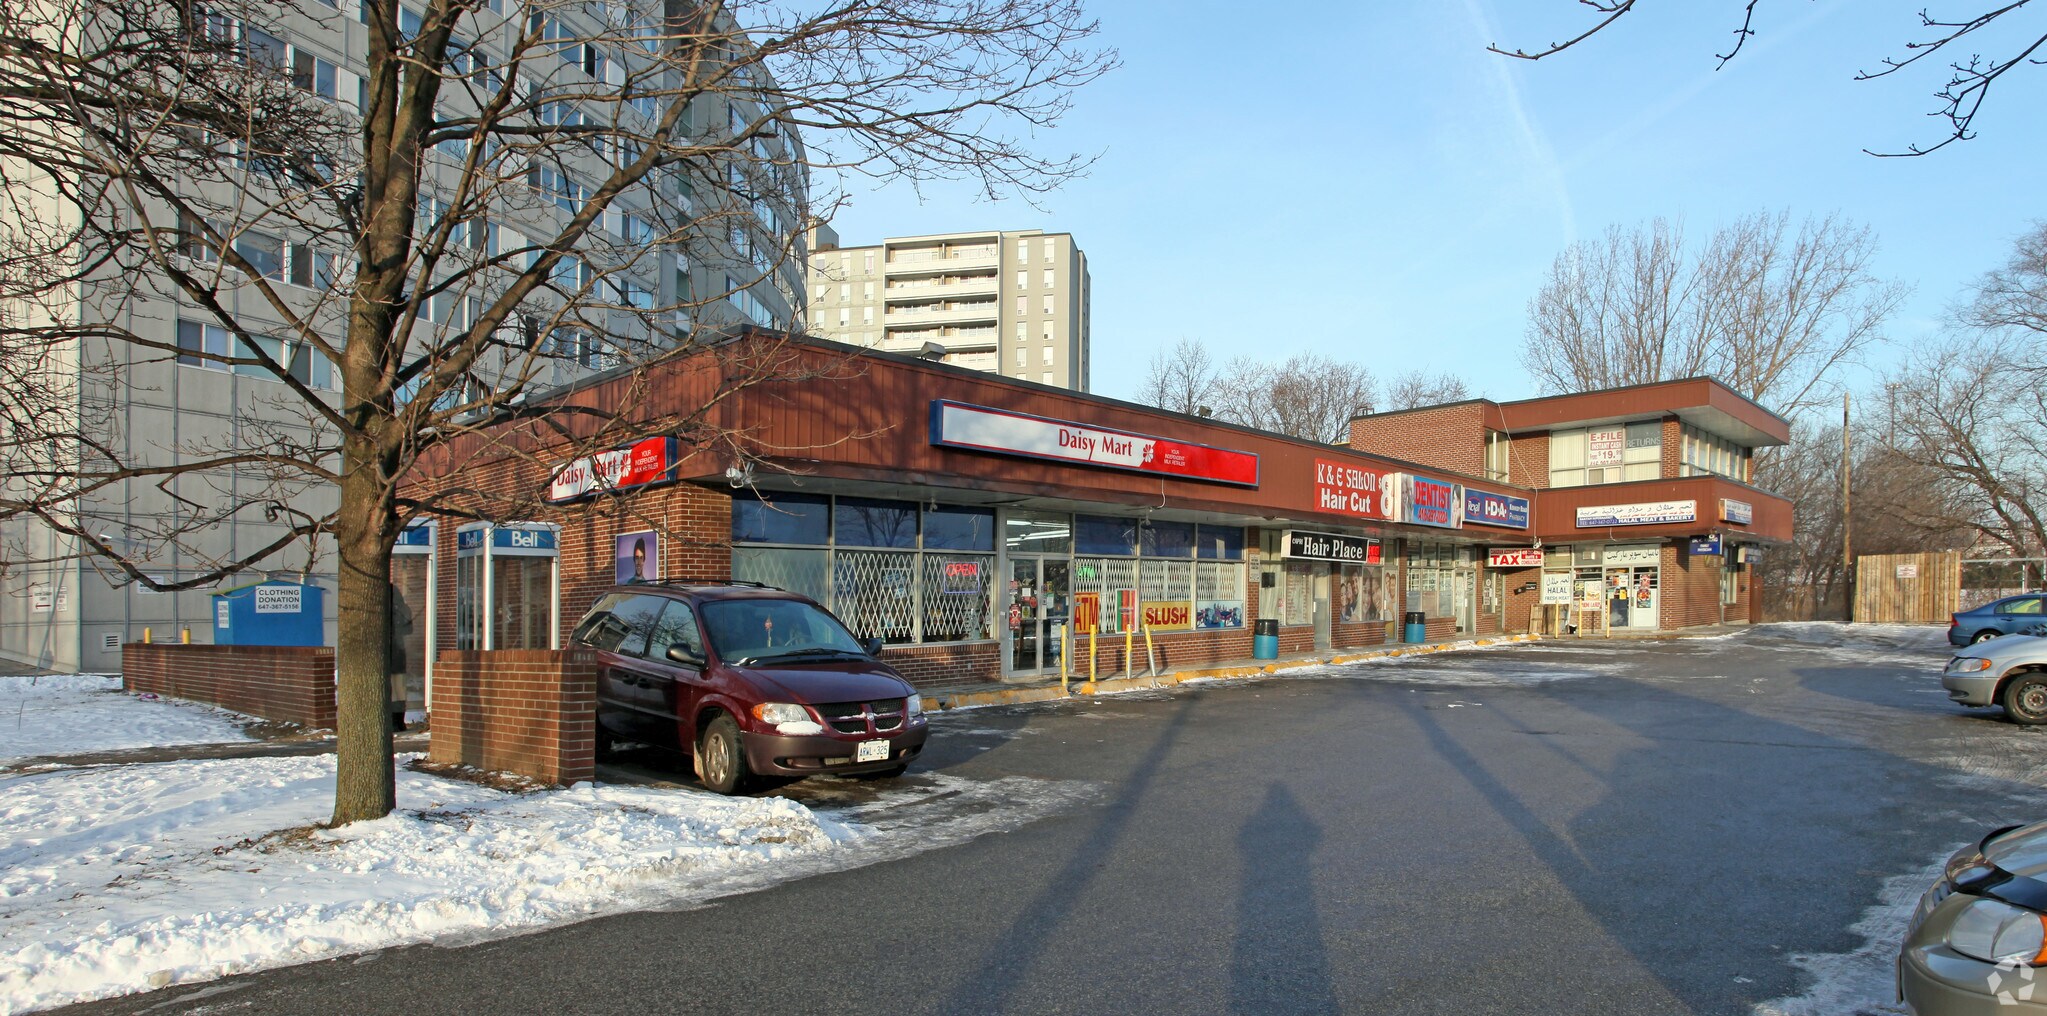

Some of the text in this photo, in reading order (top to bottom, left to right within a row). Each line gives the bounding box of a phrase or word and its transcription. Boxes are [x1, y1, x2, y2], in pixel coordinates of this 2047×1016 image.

[1059, 428, 1132, 460] Daisy Mart
[1590, 431, 1622, 441] E-FILE
[634, 455, 658, 466] INDEPENDENT
[641, 449, 652, 457] YOUR
[557, 455, 617, 494] Daisy art
[634, 466, 644, 474] MILK
[1317, 463, 1376, 492] K & E SALON
[1321, 487, 1371, 513] Hair Cut
[1415, 480, 1451, 510] DENTIST
[1666, 514, 1692, 522] BAKERY
[465, 532, 478, 548] Bell
[511, 530, 538, 547] Bell
[1303, 536, 1330, 557] Hair
[1332, 539, 1363, 559] Place
[1490, 554, 1520, 565] TAX
[945, 562, 977, 577] OPEN
[1075, 597, 1098, 631] ATM
[1145, 606, 1188, 626] SLUSH
